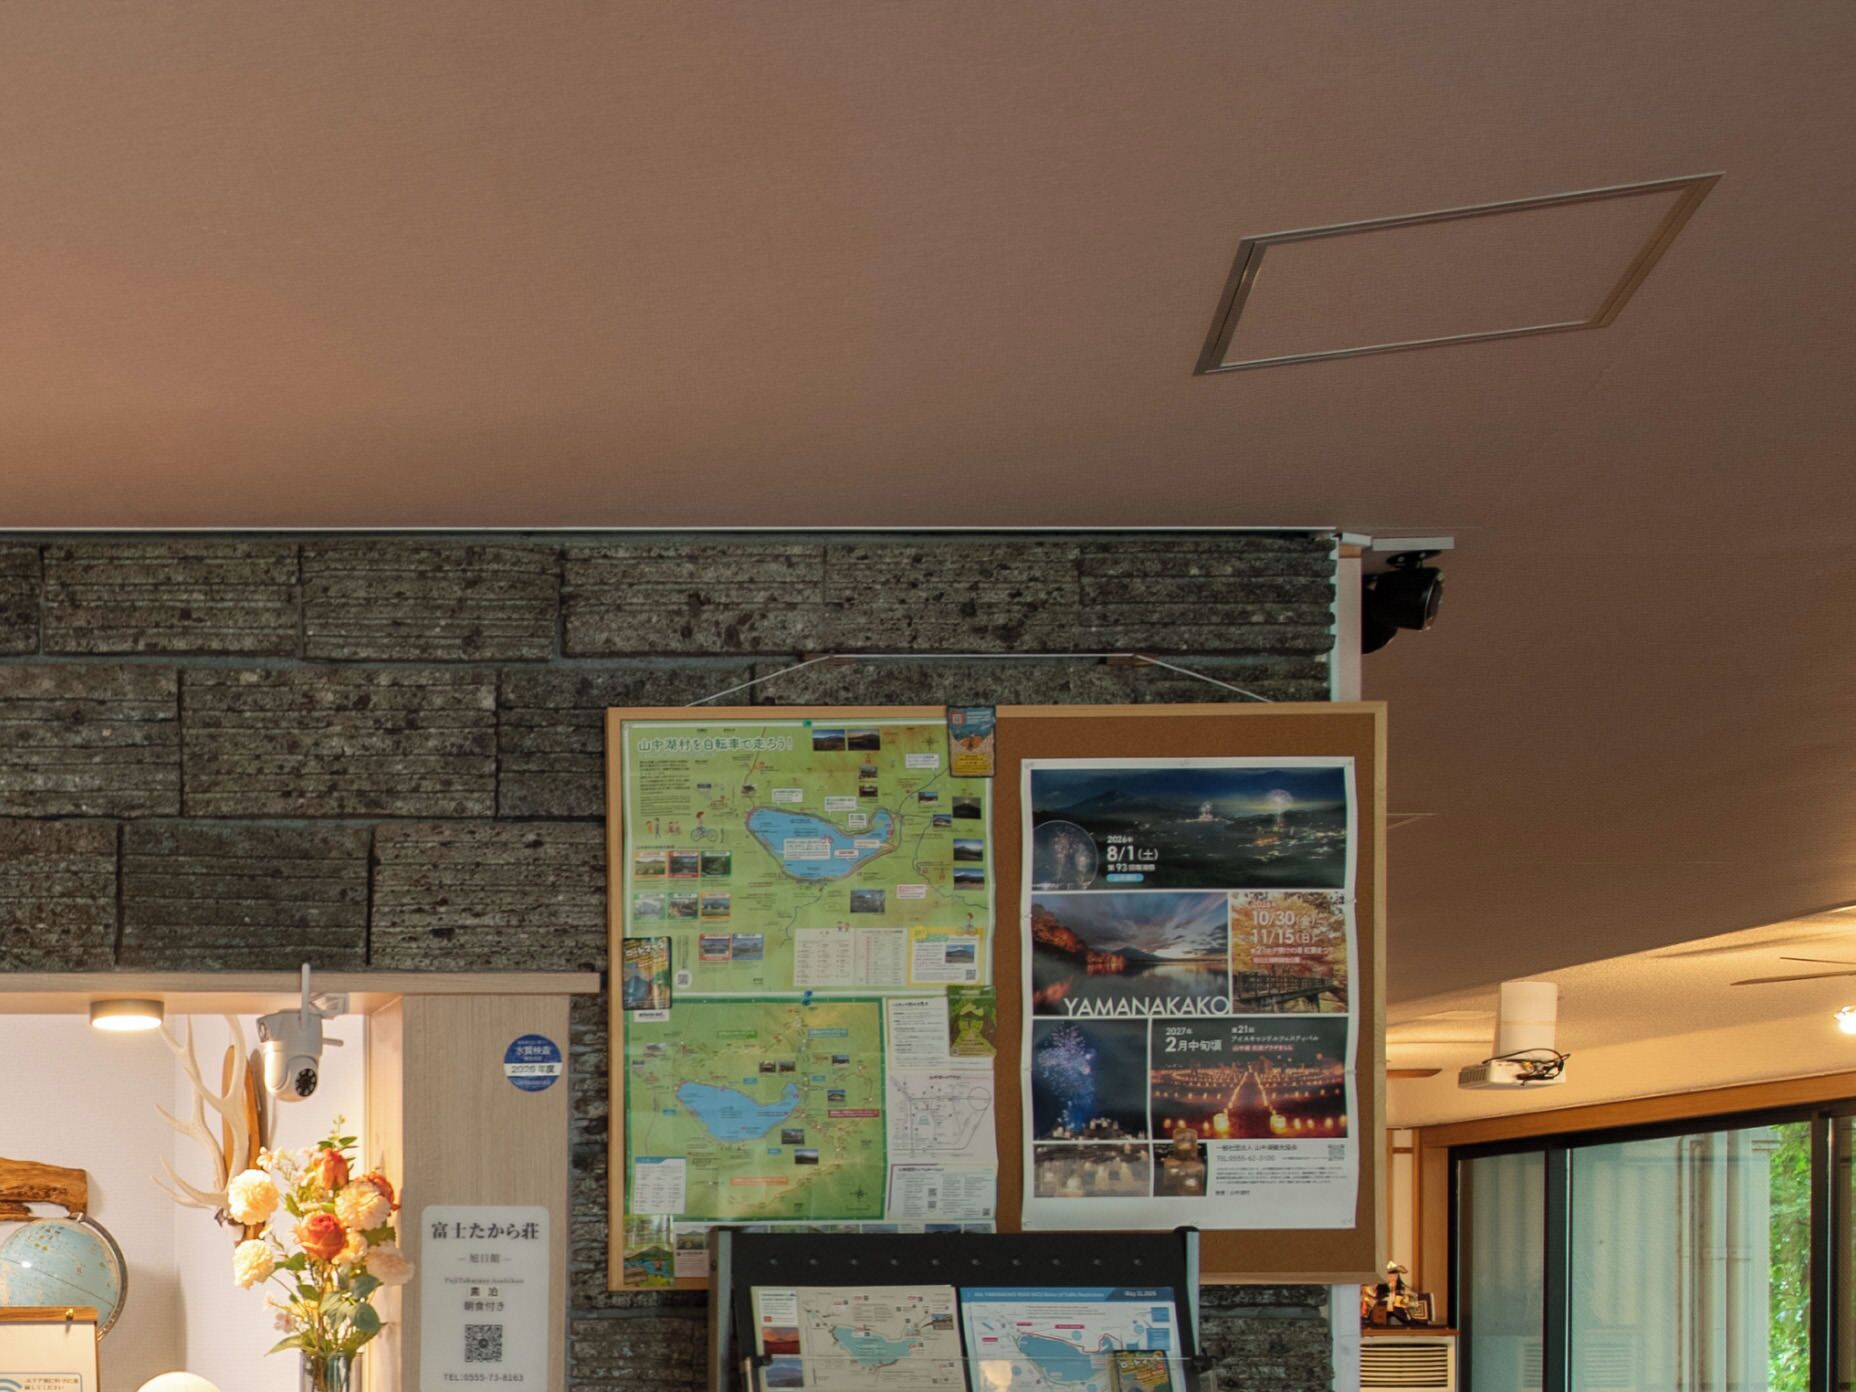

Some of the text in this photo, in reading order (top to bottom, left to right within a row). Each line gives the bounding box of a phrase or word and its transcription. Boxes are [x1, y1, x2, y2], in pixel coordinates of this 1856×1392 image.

[1064, 996, 1230, 1016] YAMANAKAKO
[431, 1221, 540, 1240] 富士たから荘
